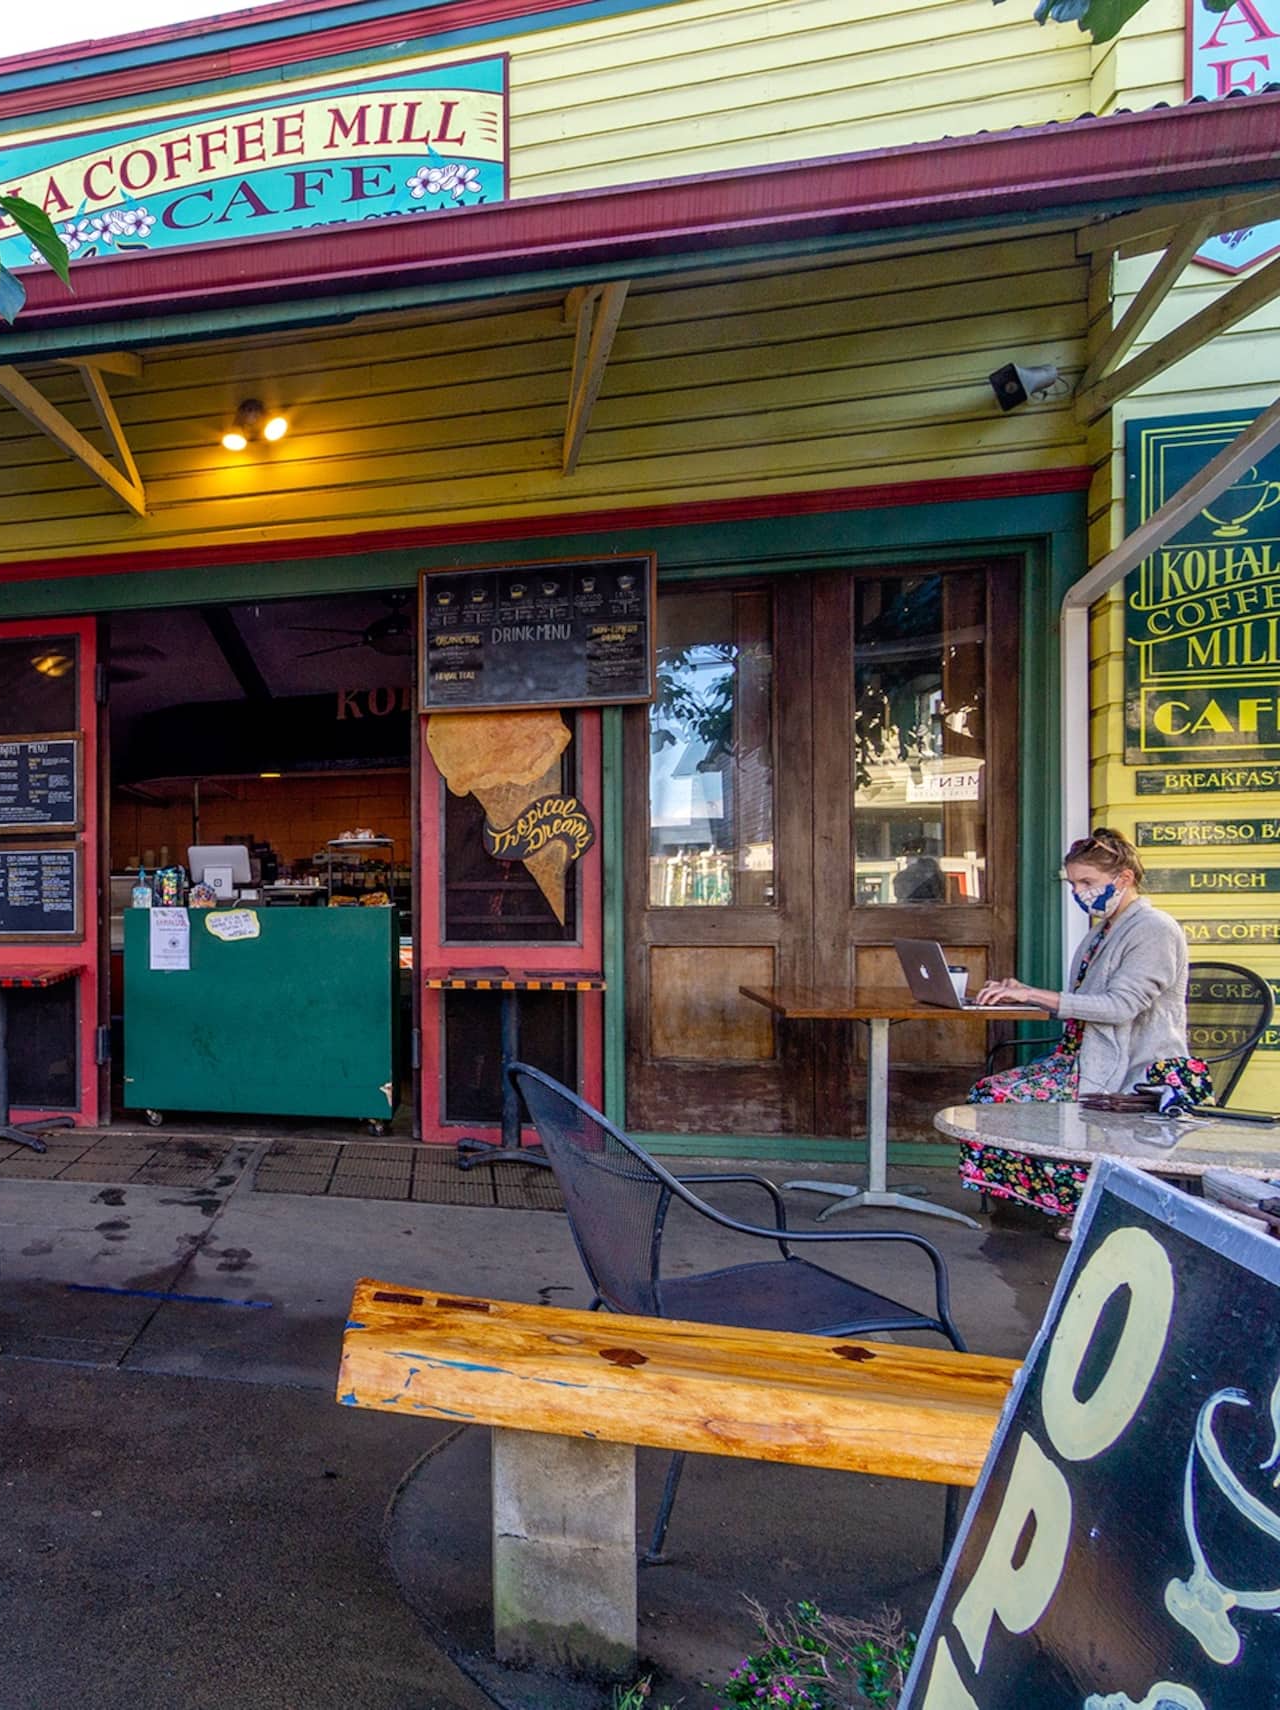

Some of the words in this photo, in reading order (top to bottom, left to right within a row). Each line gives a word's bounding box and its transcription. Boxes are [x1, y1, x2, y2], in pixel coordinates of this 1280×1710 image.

[82, 110, 306, 201] COFFEE
[322, 100, 466, 149] MILL
[161, 164, 396, 230] CAFE
[1159, 545, 1280, 602] KOHAL
[491, 625, 534, 644] DRINK
[536, 623, 571, 641] MENU
[1153, 698, 1280, 736] CAF
[487, 798, 587, 854] Tropical
[523, 816, 593, 859] Dreams
[1152, 824, 1255, 841] ESPRESSO
[1189, 873, 1267, 888] LUNCH
[1183, 924, 1211, 939] NA
